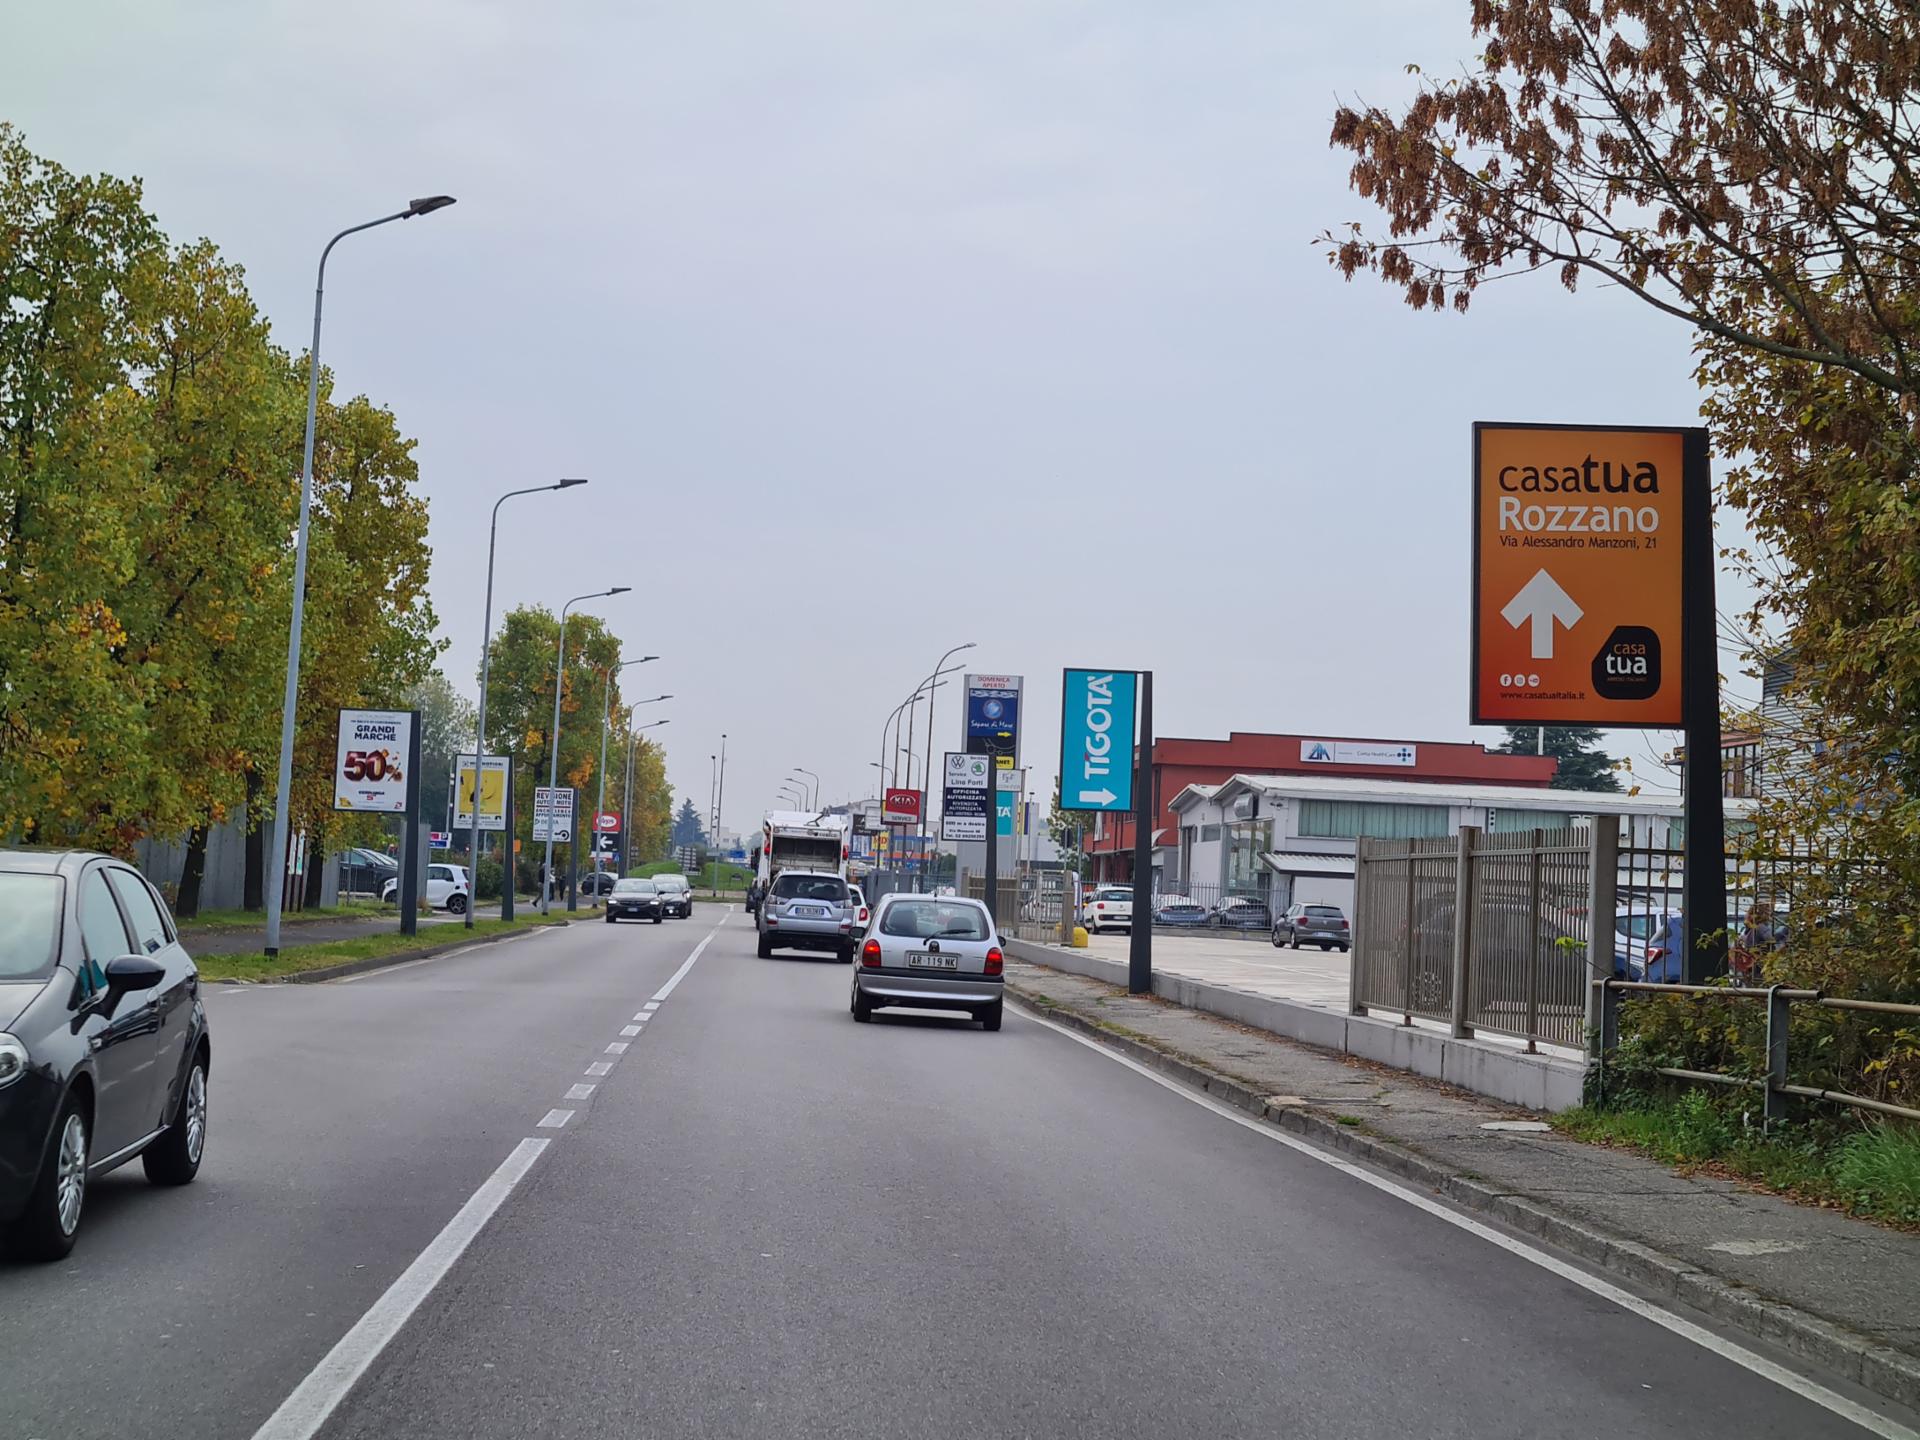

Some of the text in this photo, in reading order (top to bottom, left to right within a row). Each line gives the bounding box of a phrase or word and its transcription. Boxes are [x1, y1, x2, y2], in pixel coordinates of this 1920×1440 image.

[1498, 454, 1660, 494] casatua
[1499, 496, 1659, 533] Rozzano
[1500, 536, 1657, 550] Via Alessandro Manzoni, 21
[1613, 643, 1646, 655] casa
[1605, 653, 1648, 675] tua
[356, 724, 395, 734] GRANDI
[354, 732, 397, 741] MARCHE
[343, 748, 403, 783] 50%
[894, 796, 912, 805] KIA
[911, 955, 956, 968] AR 119 NK
